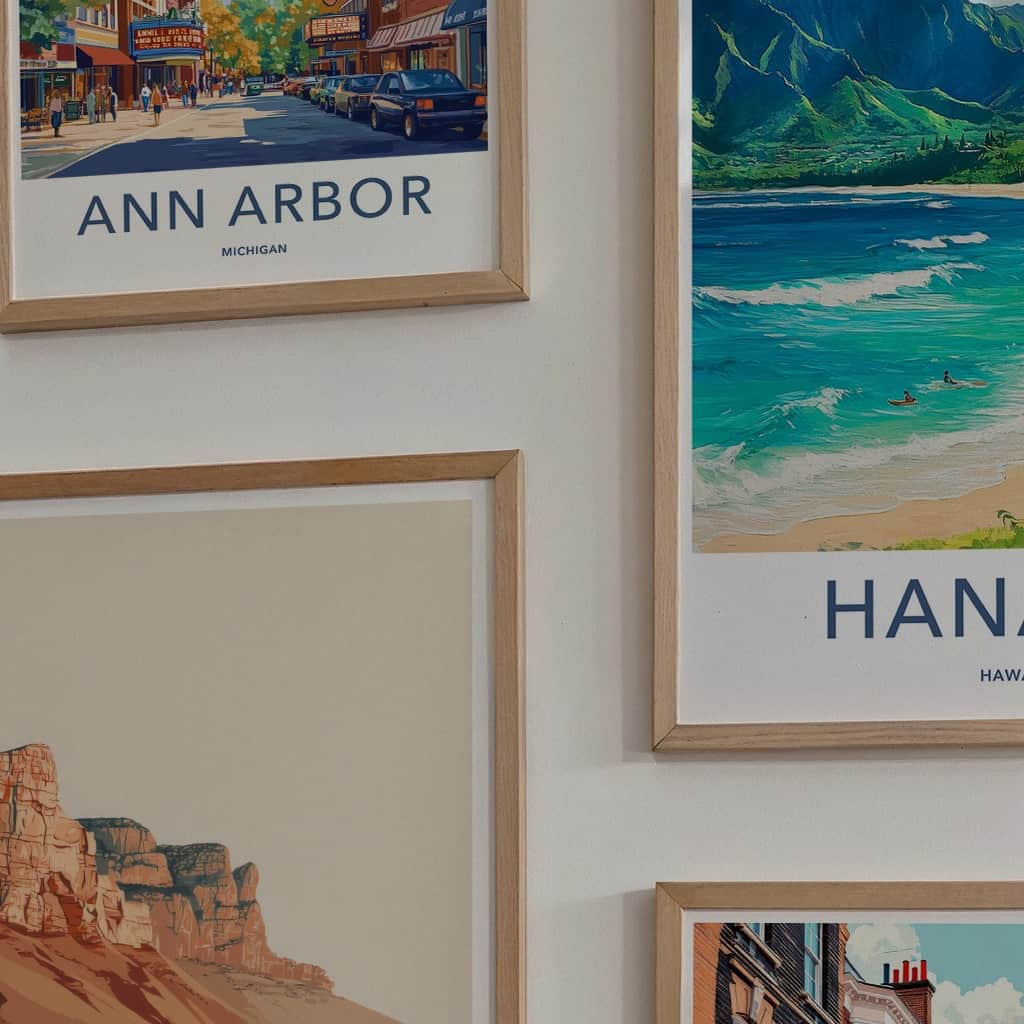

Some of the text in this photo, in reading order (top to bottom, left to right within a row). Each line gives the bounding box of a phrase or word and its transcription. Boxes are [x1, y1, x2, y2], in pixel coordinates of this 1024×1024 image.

[77, 174, 433, 236] ANN ARBOR
[221, 243, 288, 257] MICHIGAN
[826, 577, 1024, 639] HAN
[980, 668, 1024, 682] HAW
